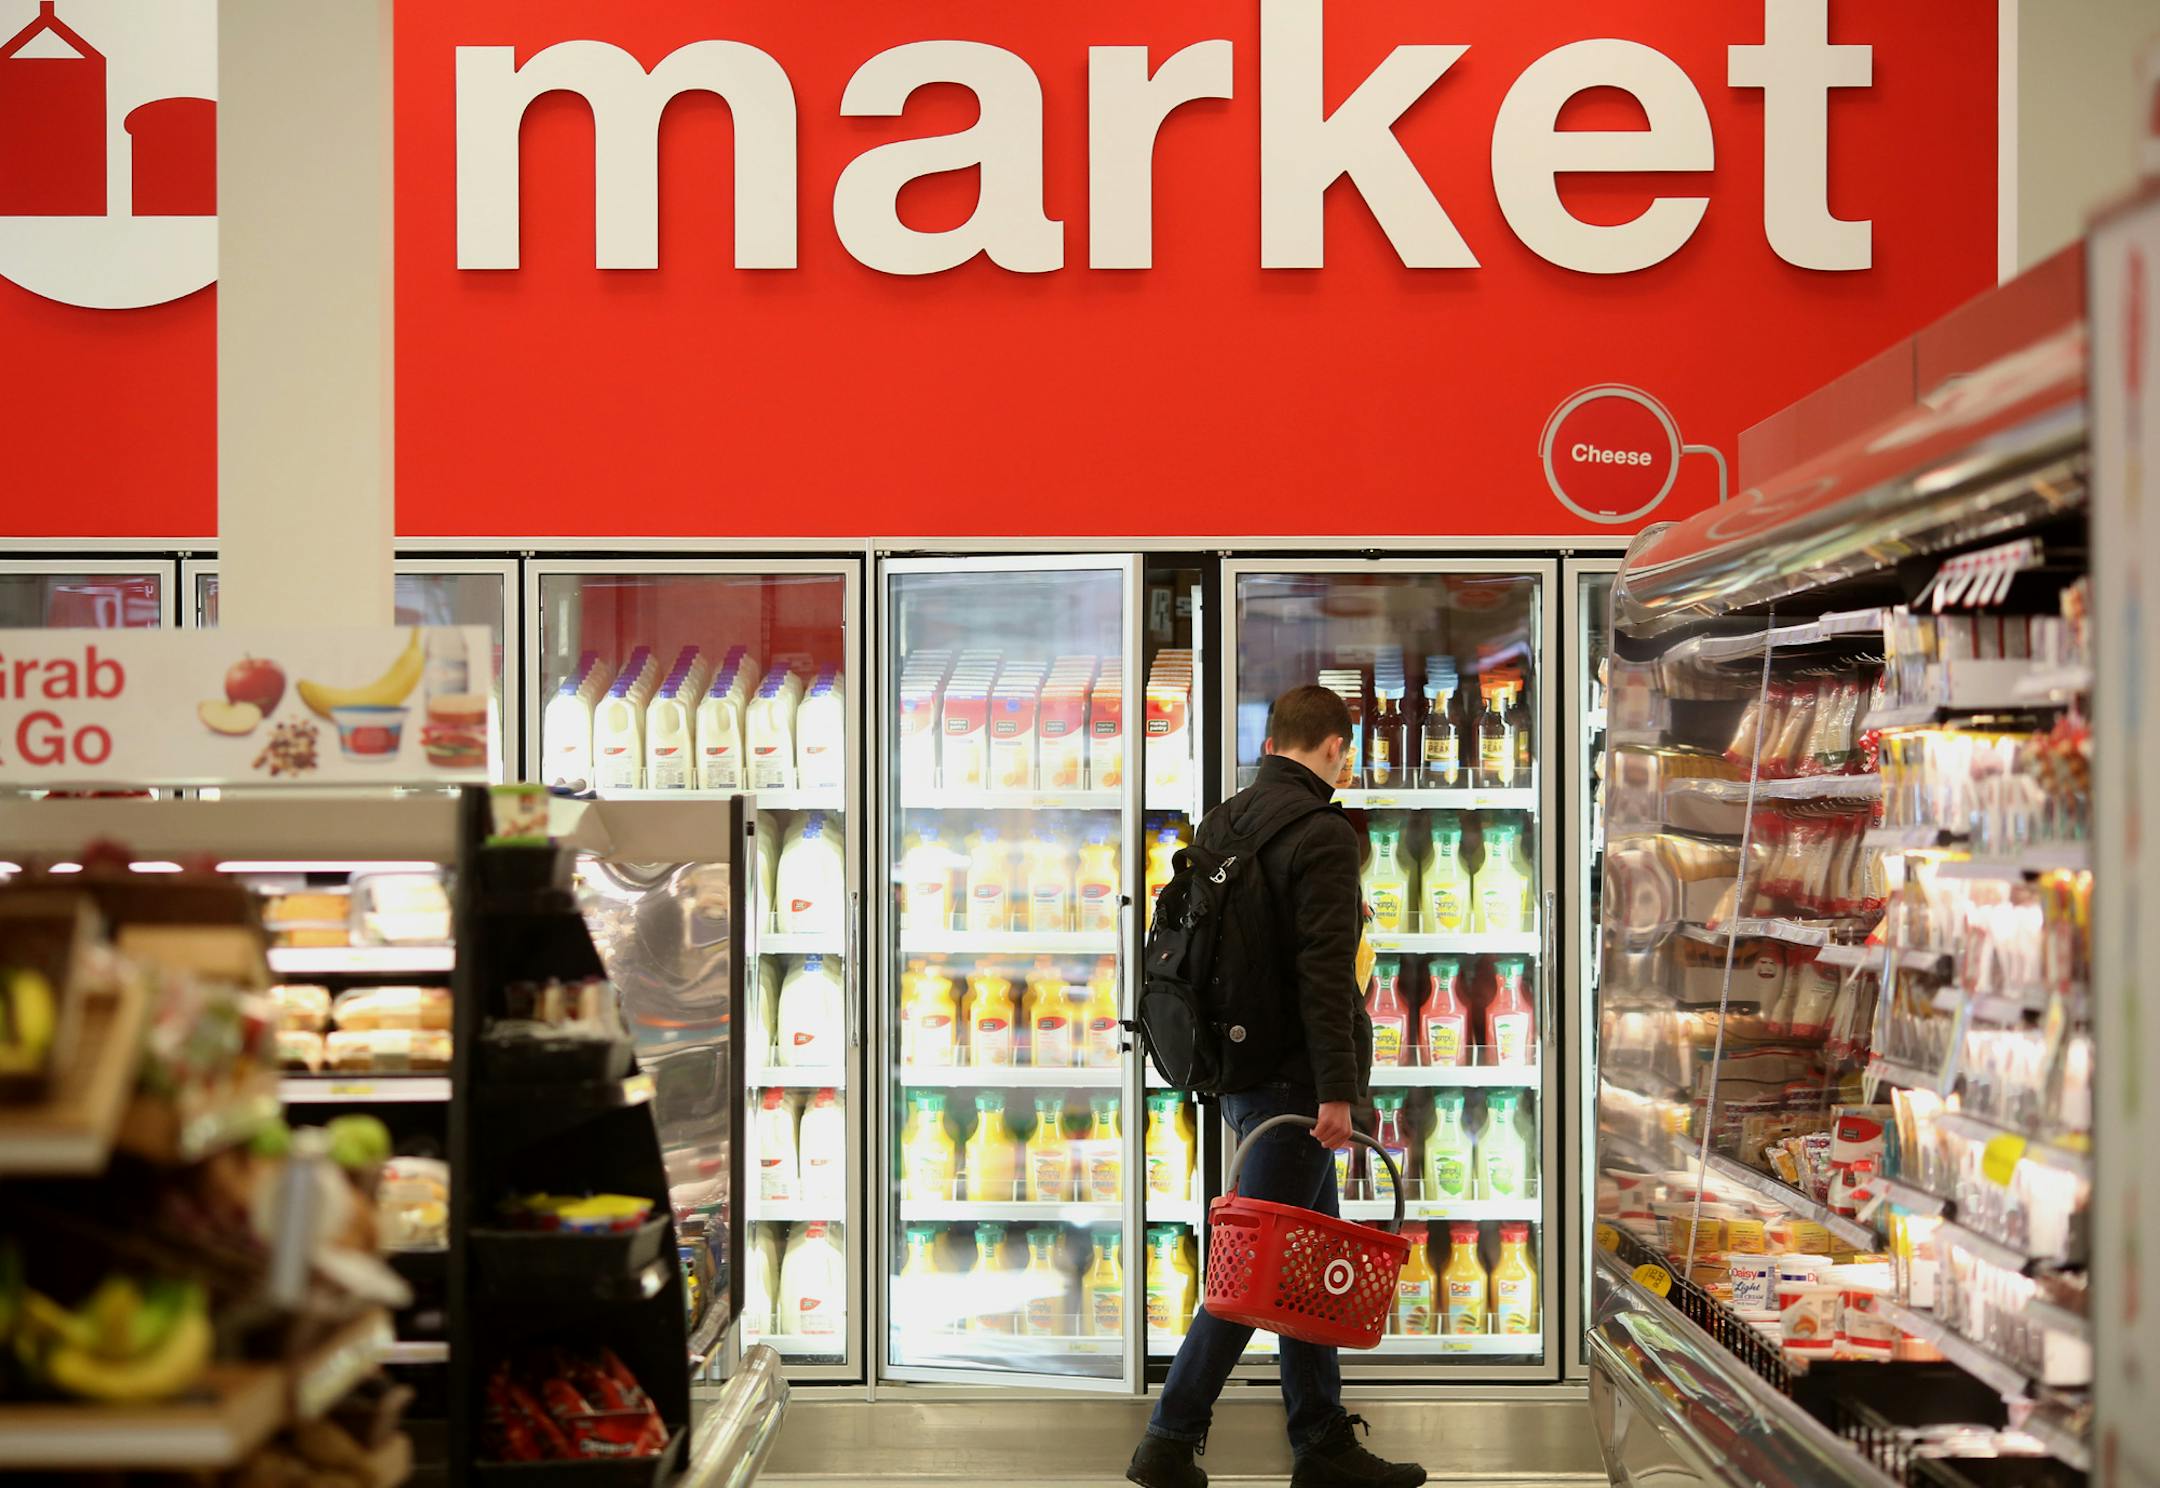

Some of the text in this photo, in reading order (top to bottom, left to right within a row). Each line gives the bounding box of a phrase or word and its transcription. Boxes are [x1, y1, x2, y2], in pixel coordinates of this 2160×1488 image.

[456, 0, 1872, 275] market
[1571, 443, 1652, 466] Cheese
[0, 644, 125, 699] rab
[16, 710, 112, 766] Go
[1732, 1267, 1757, 1280] Daisy
[1735, 1281, 1760, 1294] Light
